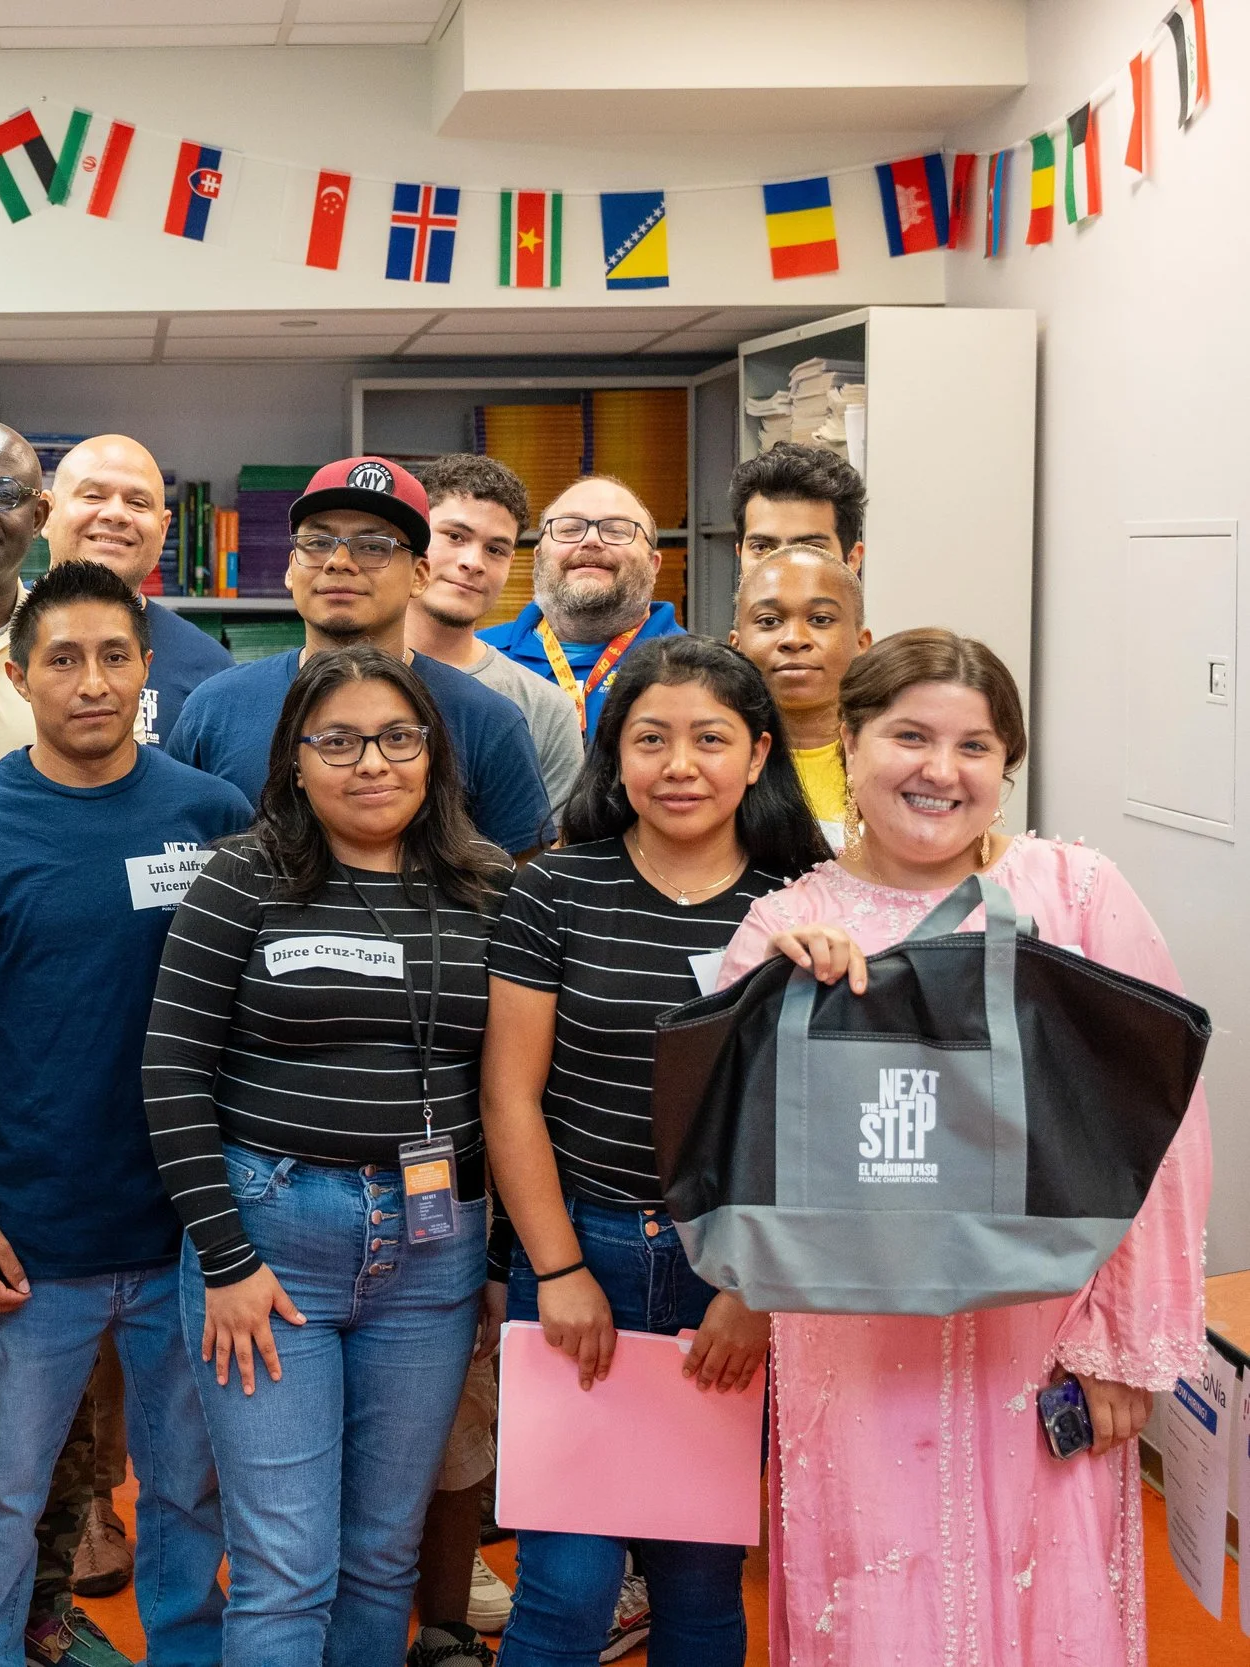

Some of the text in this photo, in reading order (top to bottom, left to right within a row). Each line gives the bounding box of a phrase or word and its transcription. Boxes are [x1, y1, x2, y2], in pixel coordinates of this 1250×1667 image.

[353, 463, 393, 481] NEW YORK
[360, 471, 383, 490] NY
[147, 860, 207, 875] Luis Alfre
[150, 880, 191, 893] Vicent
[272, 945, 396, 964] Dirce Cruz-Tapia
[860, 1068, 940, 1114] THE NEXT
[858, 1093, 937, 1159] STEP
[858, 1159, 938, 1177] EL PRÓXIMO PASO
[1202, 1373, 1227, 1409] oNía
[1187, 1396, 1208, 1421] HIRING!
